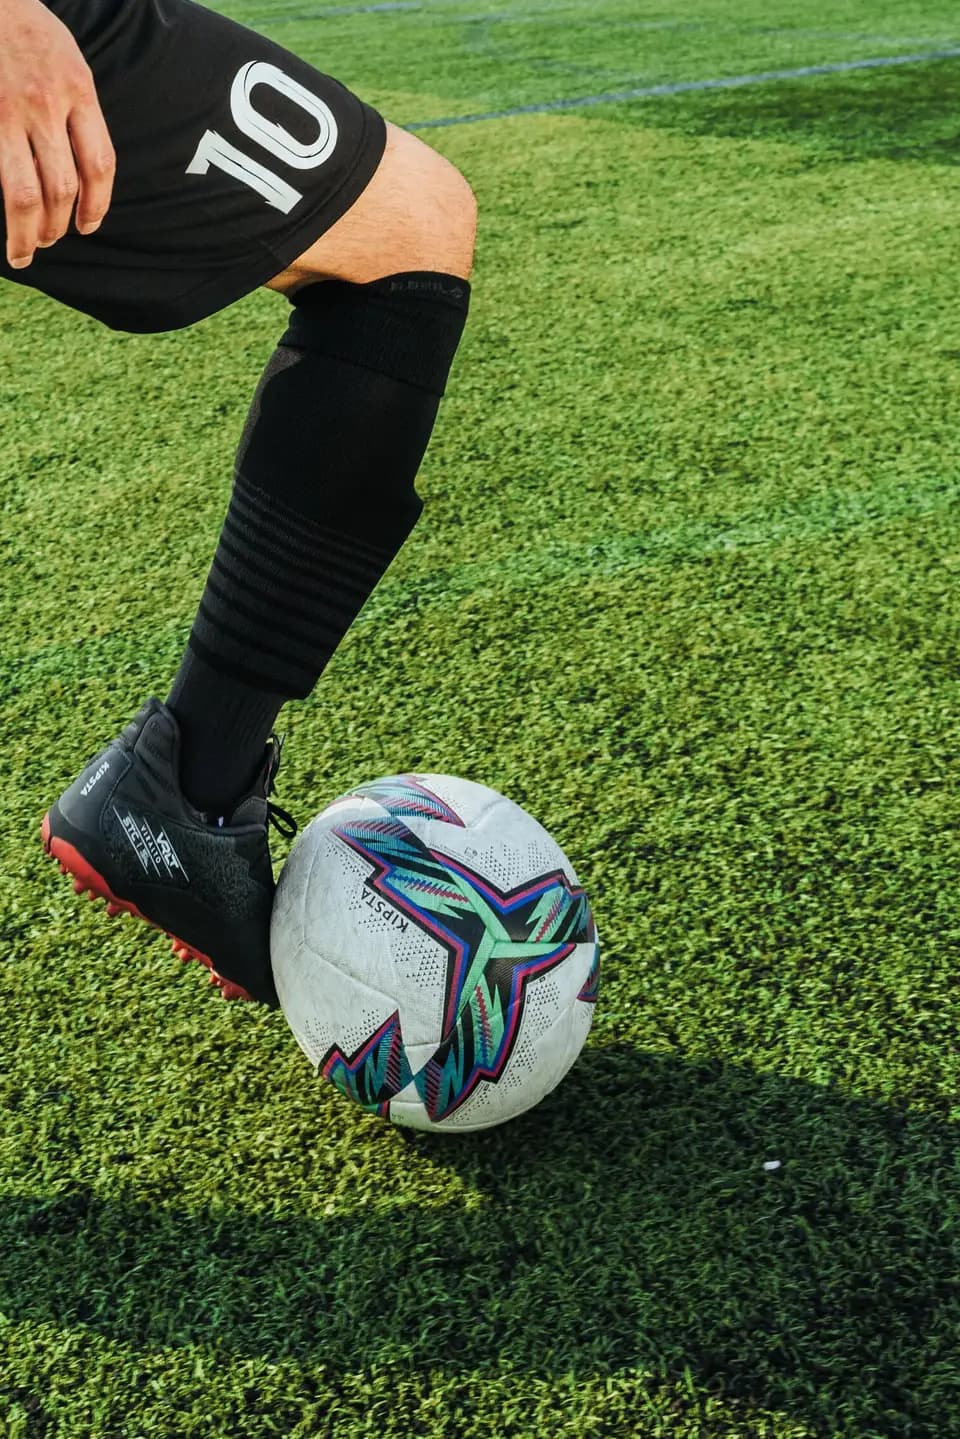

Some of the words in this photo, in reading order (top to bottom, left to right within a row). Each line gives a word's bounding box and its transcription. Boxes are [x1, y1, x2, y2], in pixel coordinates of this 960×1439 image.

[185, 60, 338, 215] 10
[80, 761, 110, 797] KIPSTA
[361, 887, 409, 933] KIPSTA
